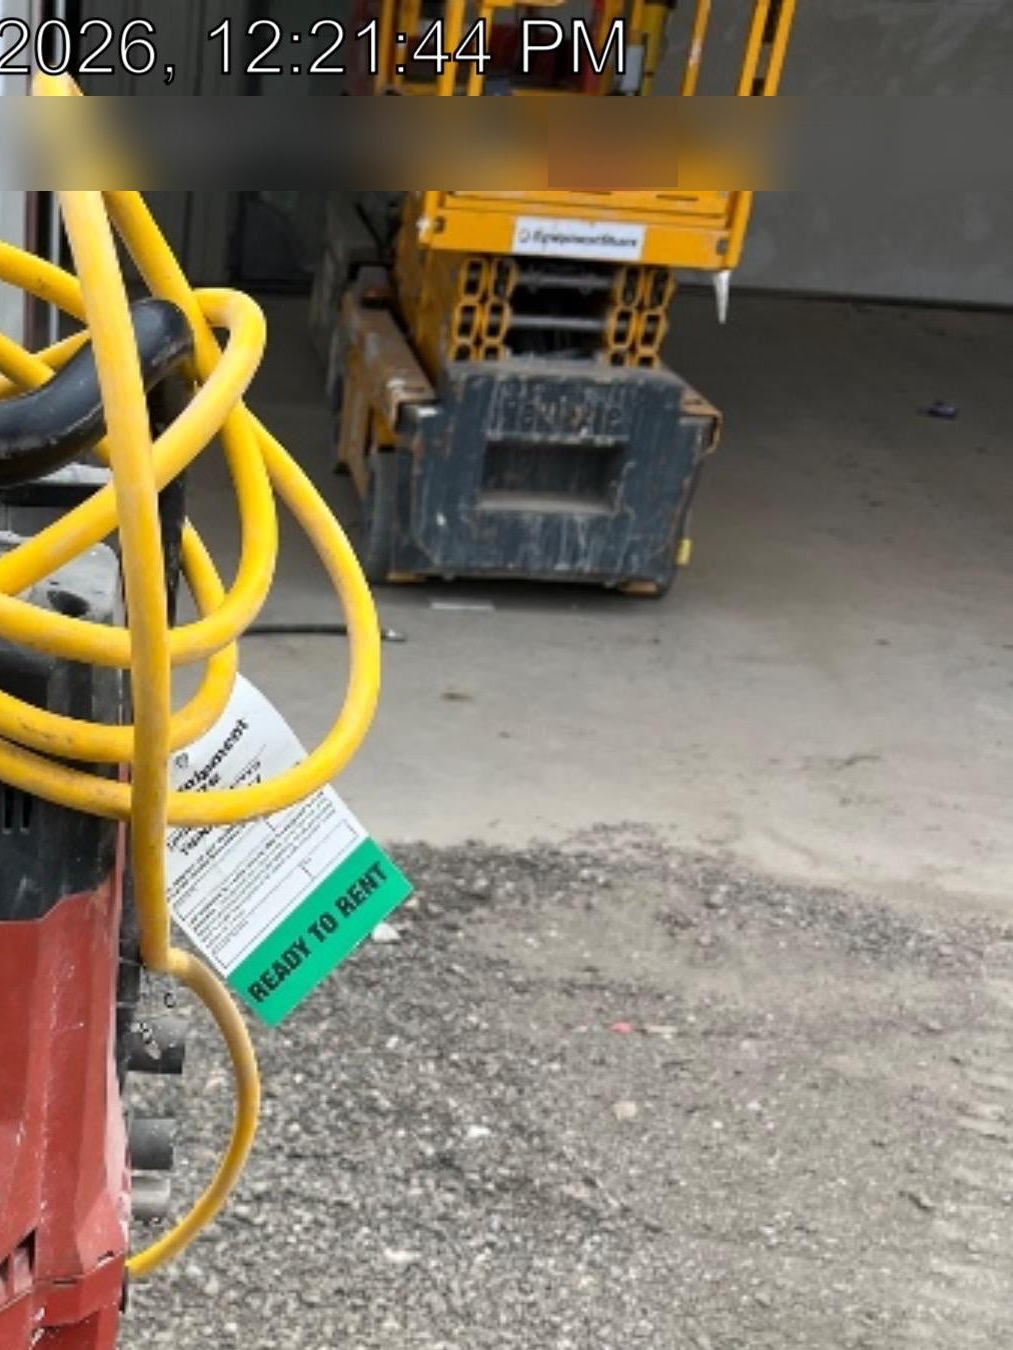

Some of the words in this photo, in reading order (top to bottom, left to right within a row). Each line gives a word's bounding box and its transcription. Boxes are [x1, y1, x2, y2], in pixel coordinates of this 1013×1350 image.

[178, 719, 249, 792] uipment
[247, 937, 312, 1003] READY
[307, 910, 339, 944] TO
[334, 861, 388, 917] RENT
